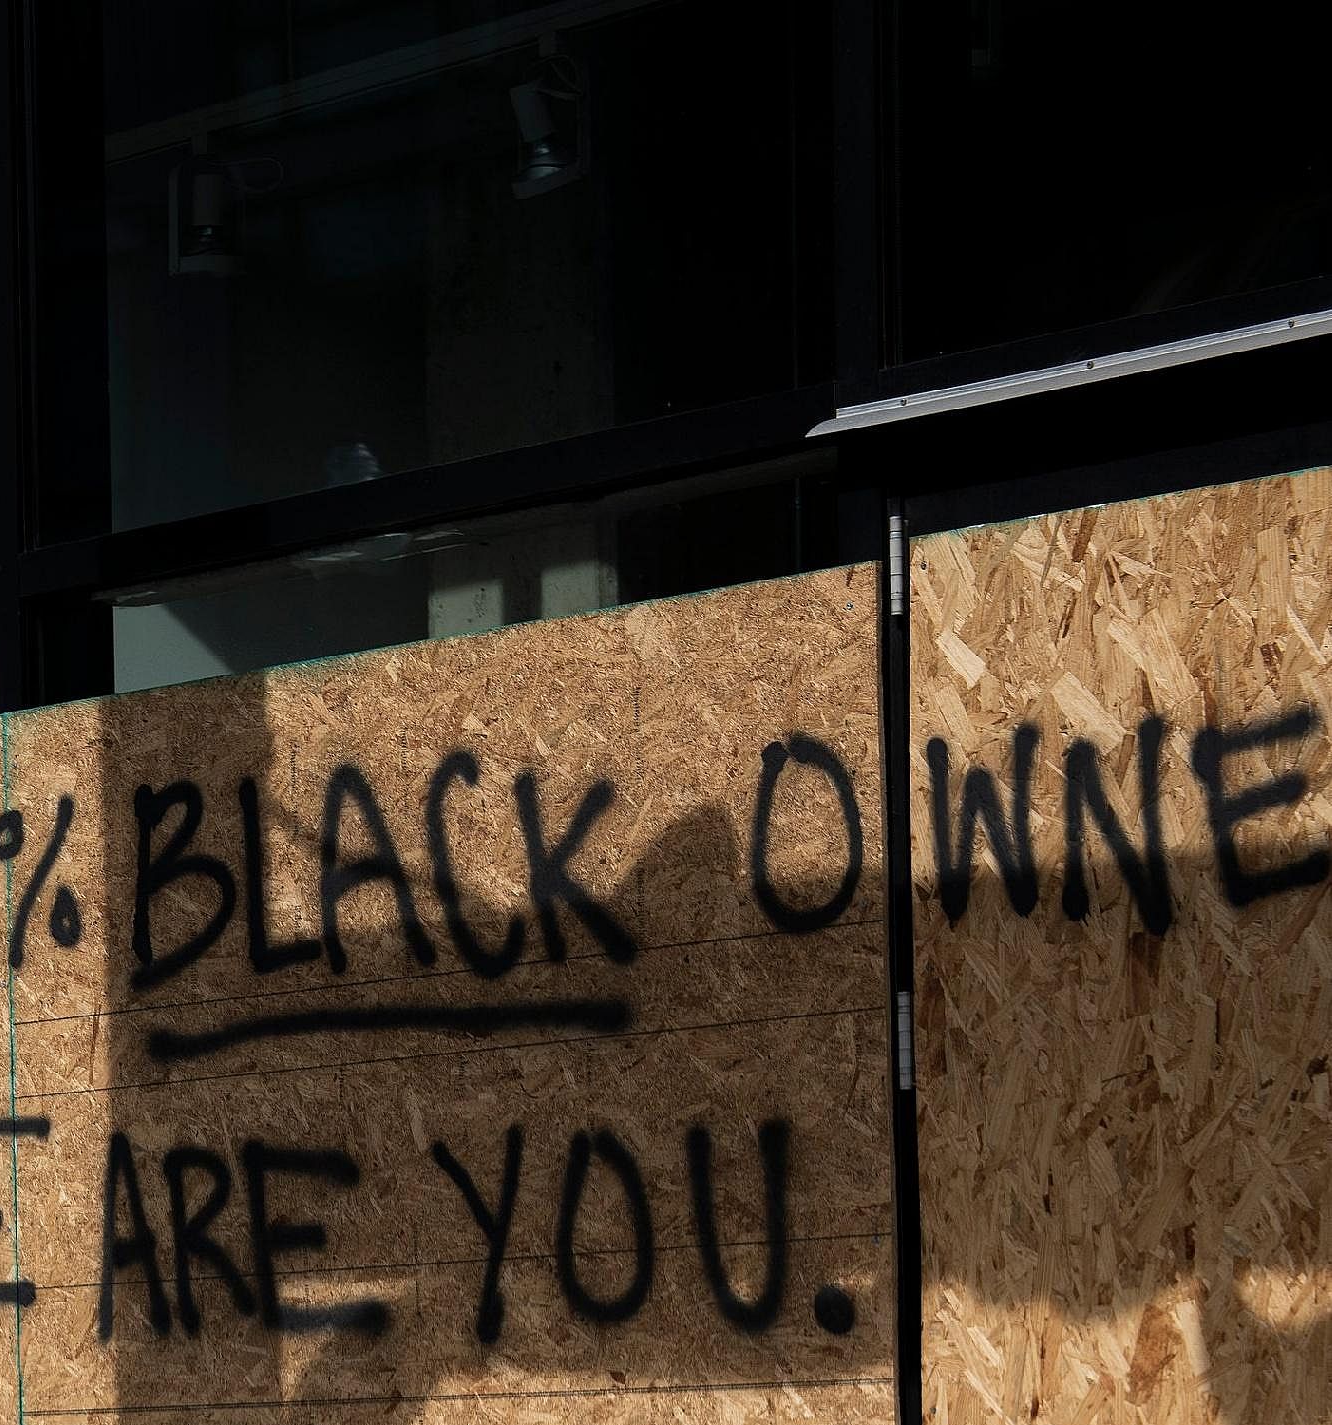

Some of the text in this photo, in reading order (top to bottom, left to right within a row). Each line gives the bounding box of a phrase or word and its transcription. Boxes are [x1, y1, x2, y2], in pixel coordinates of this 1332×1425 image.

[133, 749, 638, 990] BLACK
[99, 1129, 392, 1344] ARE
[431, 1118, 855, 1345] YOU.
